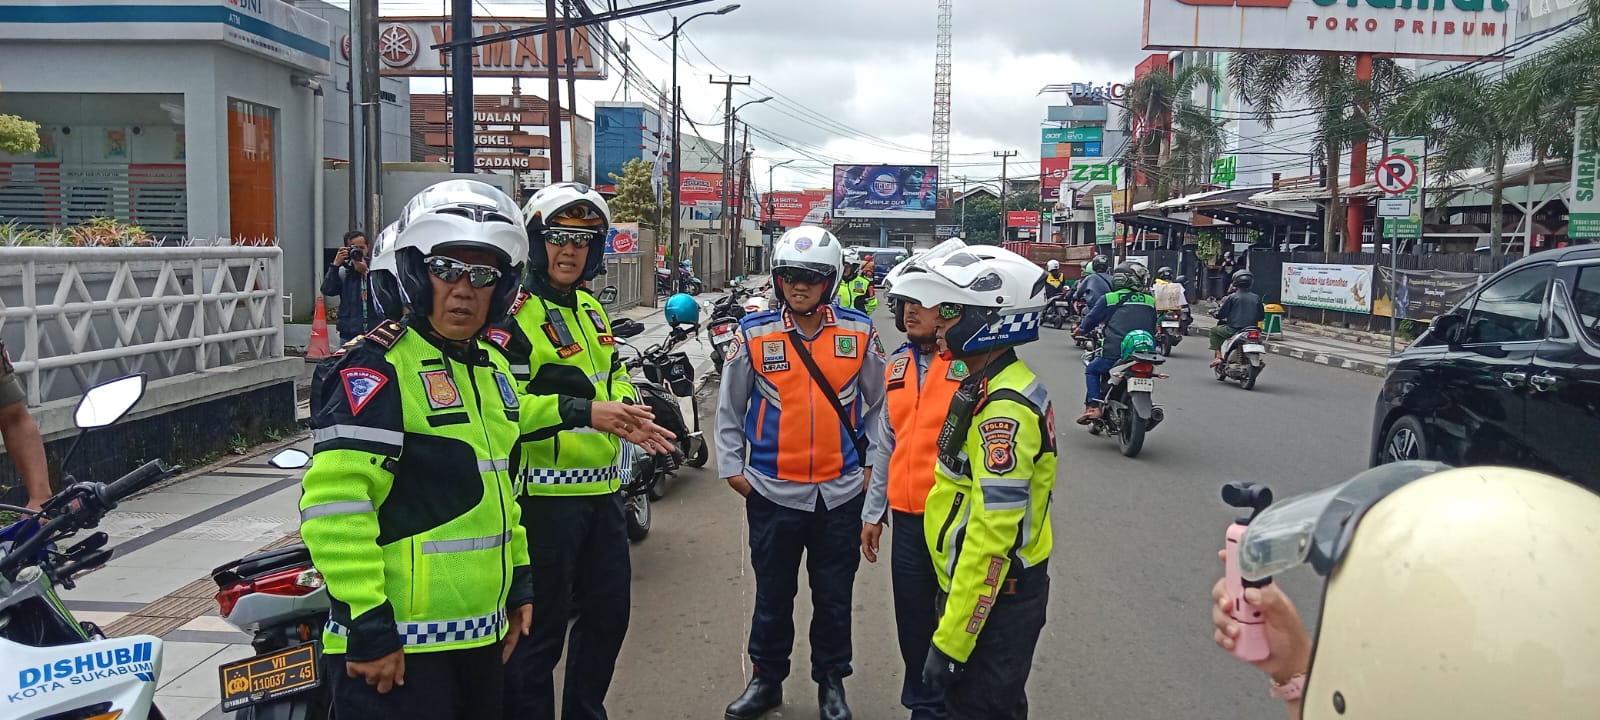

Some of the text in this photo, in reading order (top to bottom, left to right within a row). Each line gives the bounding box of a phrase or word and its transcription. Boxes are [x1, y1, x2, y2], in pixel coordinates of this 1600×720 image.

[1307, 16, 1508, 37] TOKO PRIBUMI
[431, 25, 593, 68] YMAHA
[447, 111, 521, 123] PJUALAN
[474, 135, 512, 146] NGKEL
[477, 157, 529, 168] CADANG
[1120, 293, 1145, 303] Gab
[985, 422, 1009, 431] POLDA
[965, 554, 1004, 635] POLISI
[19, 648, 132, 689] DISHUB
[272, 656, 286, 669] VII
[8, 662, 154, 703] KOTA SUKABUMI
[253, 672, 286, 691] 110037
[299, 665, 311, 680] 45
